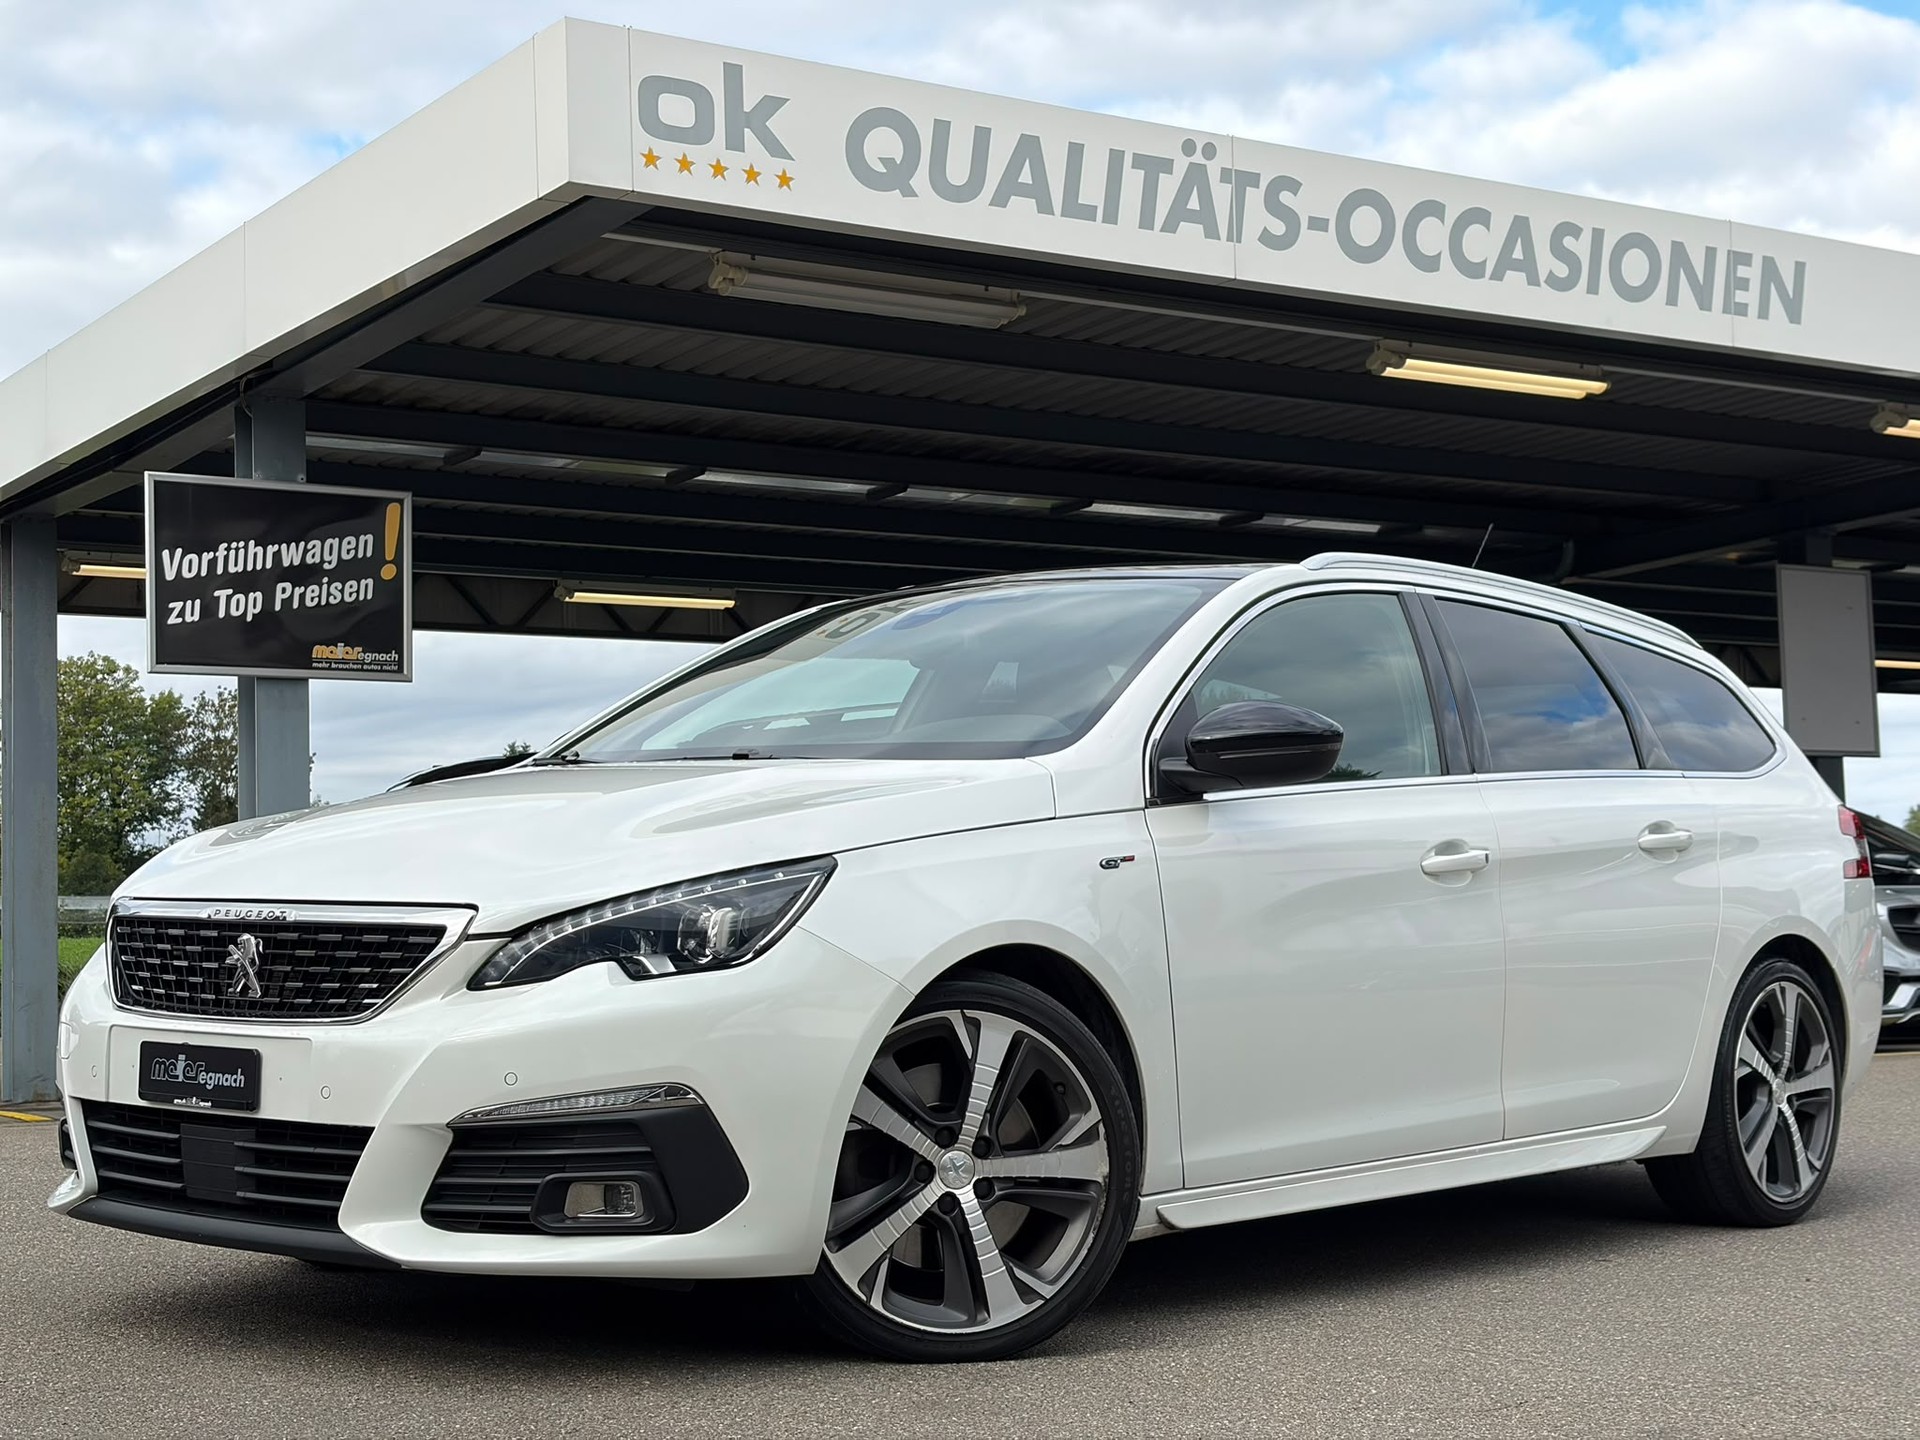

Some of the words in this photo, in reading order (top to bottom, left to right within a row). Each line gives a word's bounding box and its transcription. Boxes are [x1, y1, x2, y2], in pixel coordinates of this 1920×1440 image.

[638, 61, 795, 161] ok
[845, 105, 1806, 325] QUALITÄTS-OCCASIONEN
[161, 533, 374, 581] Vorführwagen
[166, 599, 201, 625] zu
[213, 588, 263, 622] Top
[274, 577, 374, 611] Preisen
[331, 662, 361, 670] brauchen
[214, 909, 287, 919] PEUGEOT
